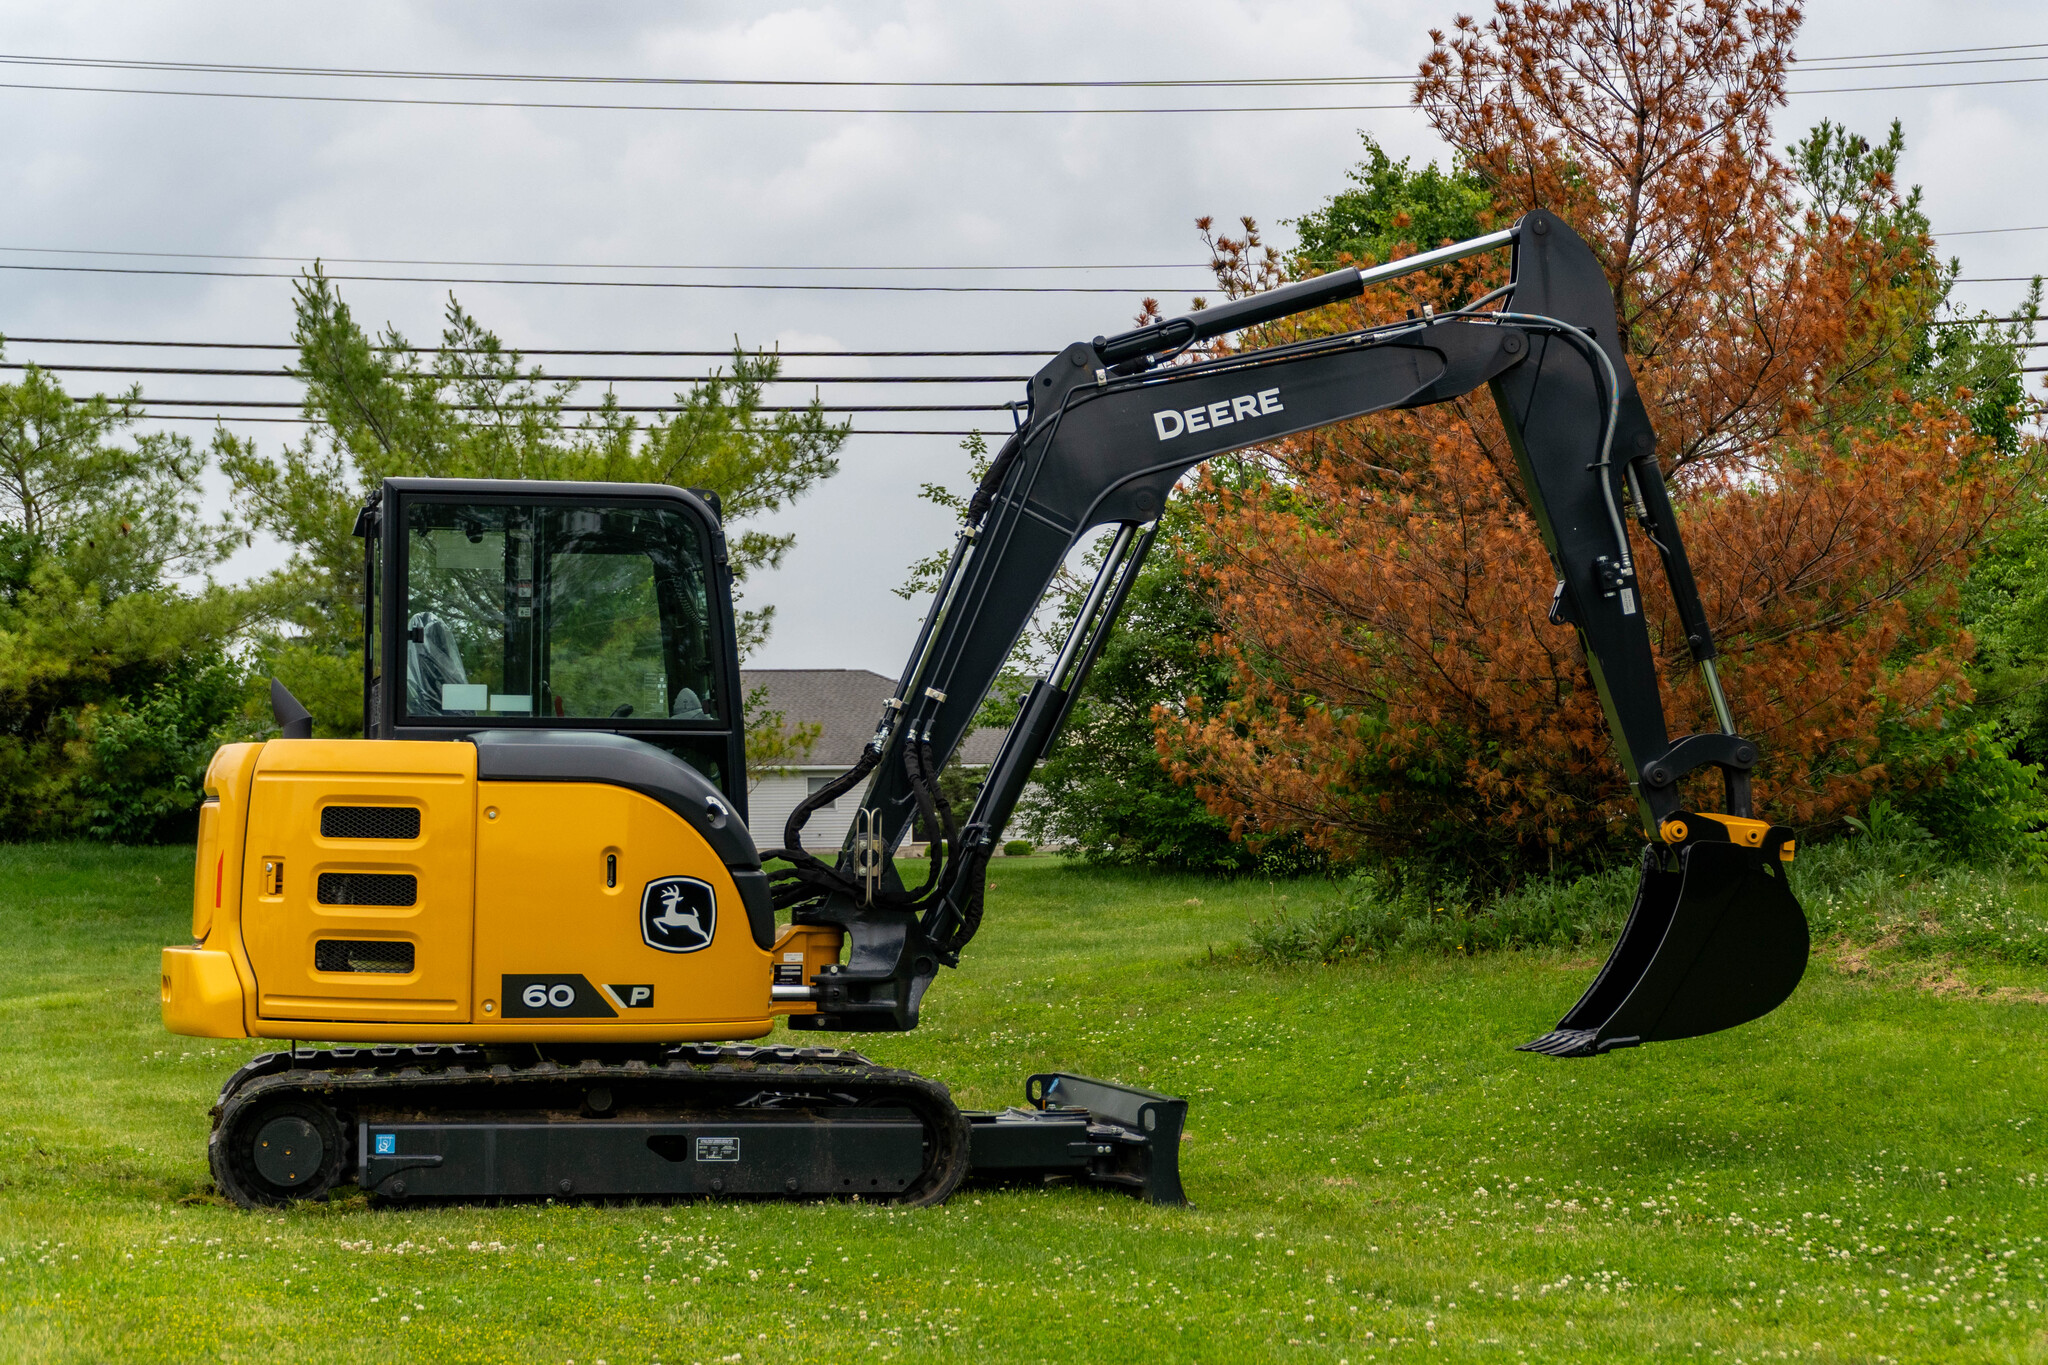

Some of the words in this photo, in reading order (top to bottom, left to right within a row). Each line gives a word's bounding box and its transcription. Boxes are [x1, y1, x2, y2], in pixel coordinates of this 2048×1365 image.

[1153, 387, 1284, 441] DEERE
[522, 984, 576, 1008] 60
[629, 986, 651, 1006] P
